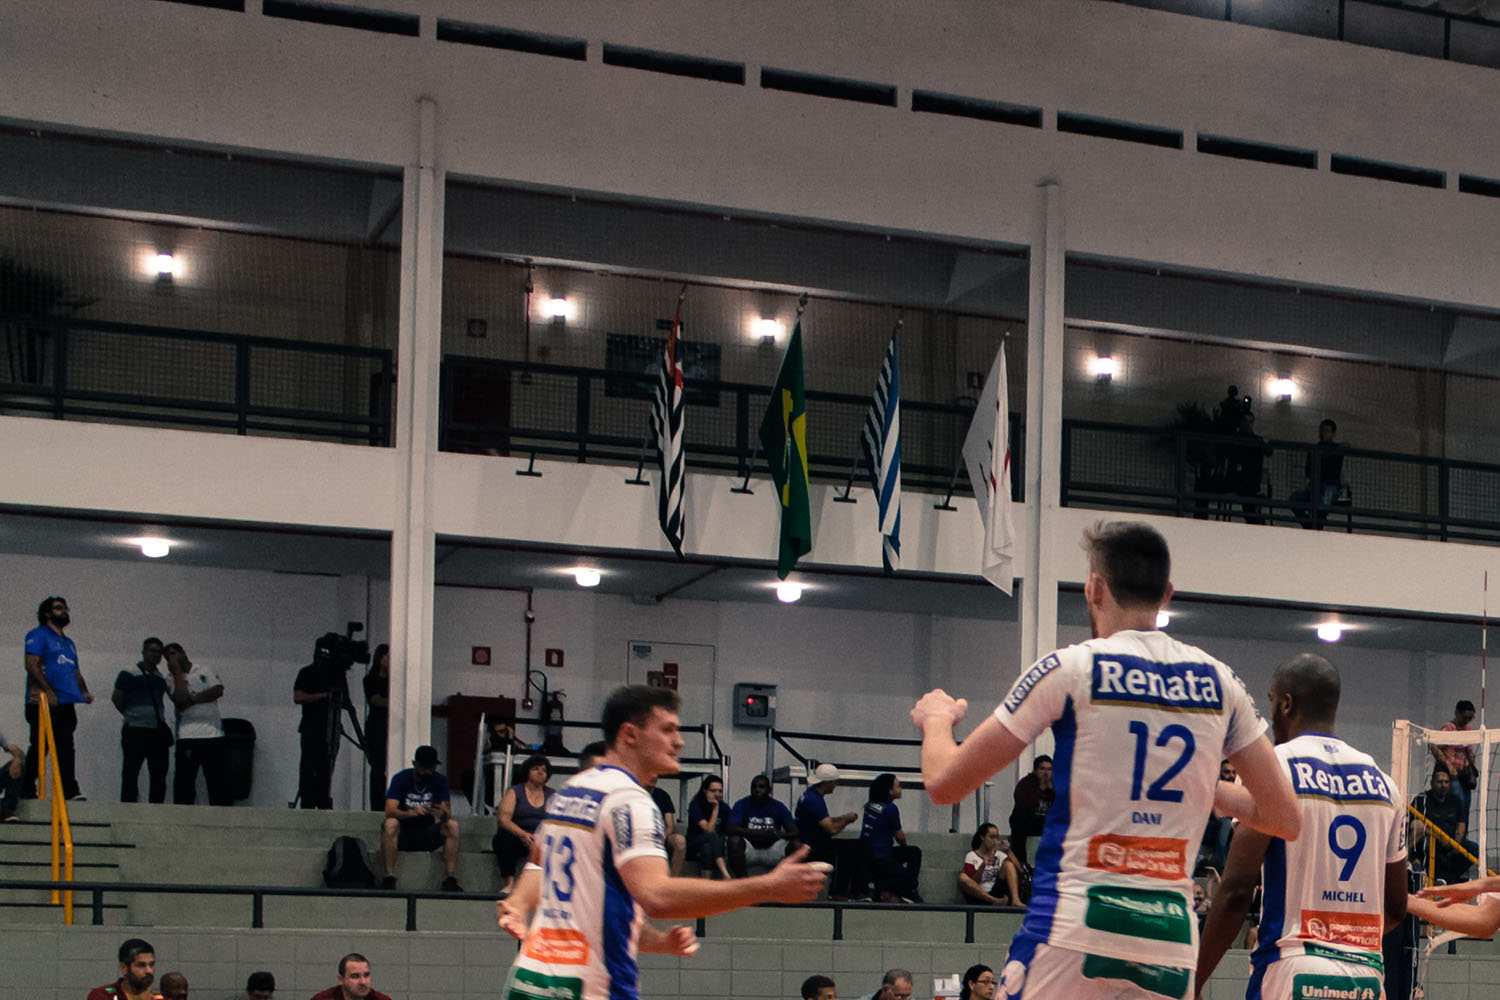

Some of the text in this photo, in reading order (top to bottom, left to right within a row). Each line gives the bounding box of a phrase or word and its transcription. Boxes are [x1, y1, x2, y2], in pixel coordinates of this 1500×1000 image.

[1097, 660, 1220, 703] Renata
[1128, 720, 1196, 803] 12
[1292, 762, 1390, 799] Renata
[545, 834, 575, 902] 13
[1328, 814, 1367, 882] 9
[1322, 890, 1366, 903] MICHEL
[1302, 985, 1359, 1000] Unimed
